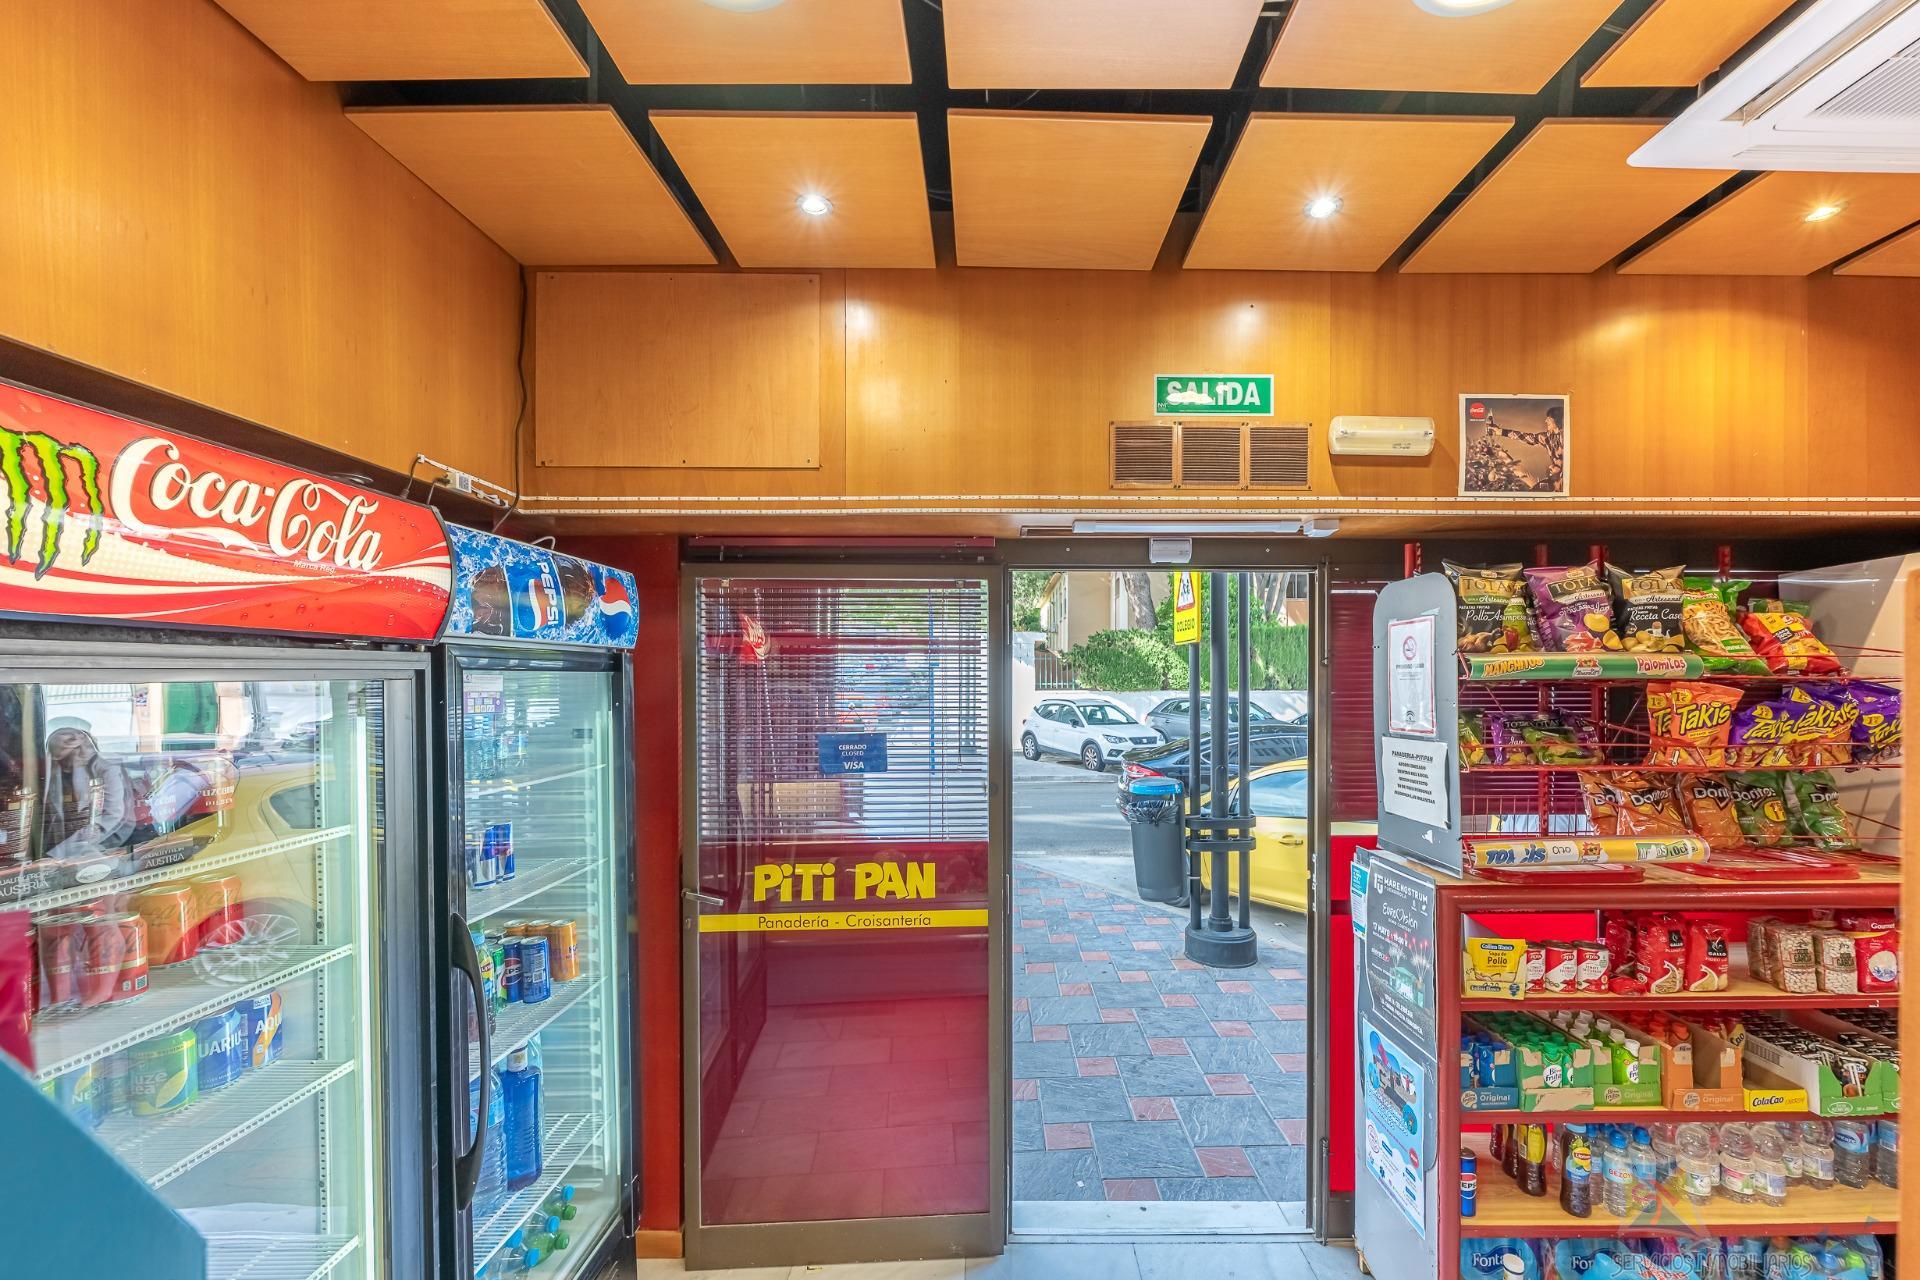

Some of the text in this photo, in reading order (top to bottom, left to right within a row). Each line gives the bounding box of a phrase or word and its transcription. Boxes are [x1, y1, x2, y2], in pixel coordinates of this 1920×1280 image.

[1167, 380, 1261, 406] SALIDA
[110, 437, 383, 572] Coca-Cola
[537, 562, 559, 627] PEPSI
[1177, 618, 1195, 633] COLEGIO
[1638, 656, 1686, 672] Palomitas
[1677, 702, 1732, 735] Takis
[145, 853, 185, 868] AUSTRIA
[855, 862, 936, 900] PAN
[1384, 877, 1428, 904] MARENOSTRUM
[758, 915, 829, 929] Panadería
[845, 913, 931, 928] Croisantería
[1487, 957, 1508, 965] Pollo
[1624, 1091, 1653, 1099] Original
[1703, 1096, 1733, 1104] Original
[1753, 1096, 1784, 1107] ColaCao
